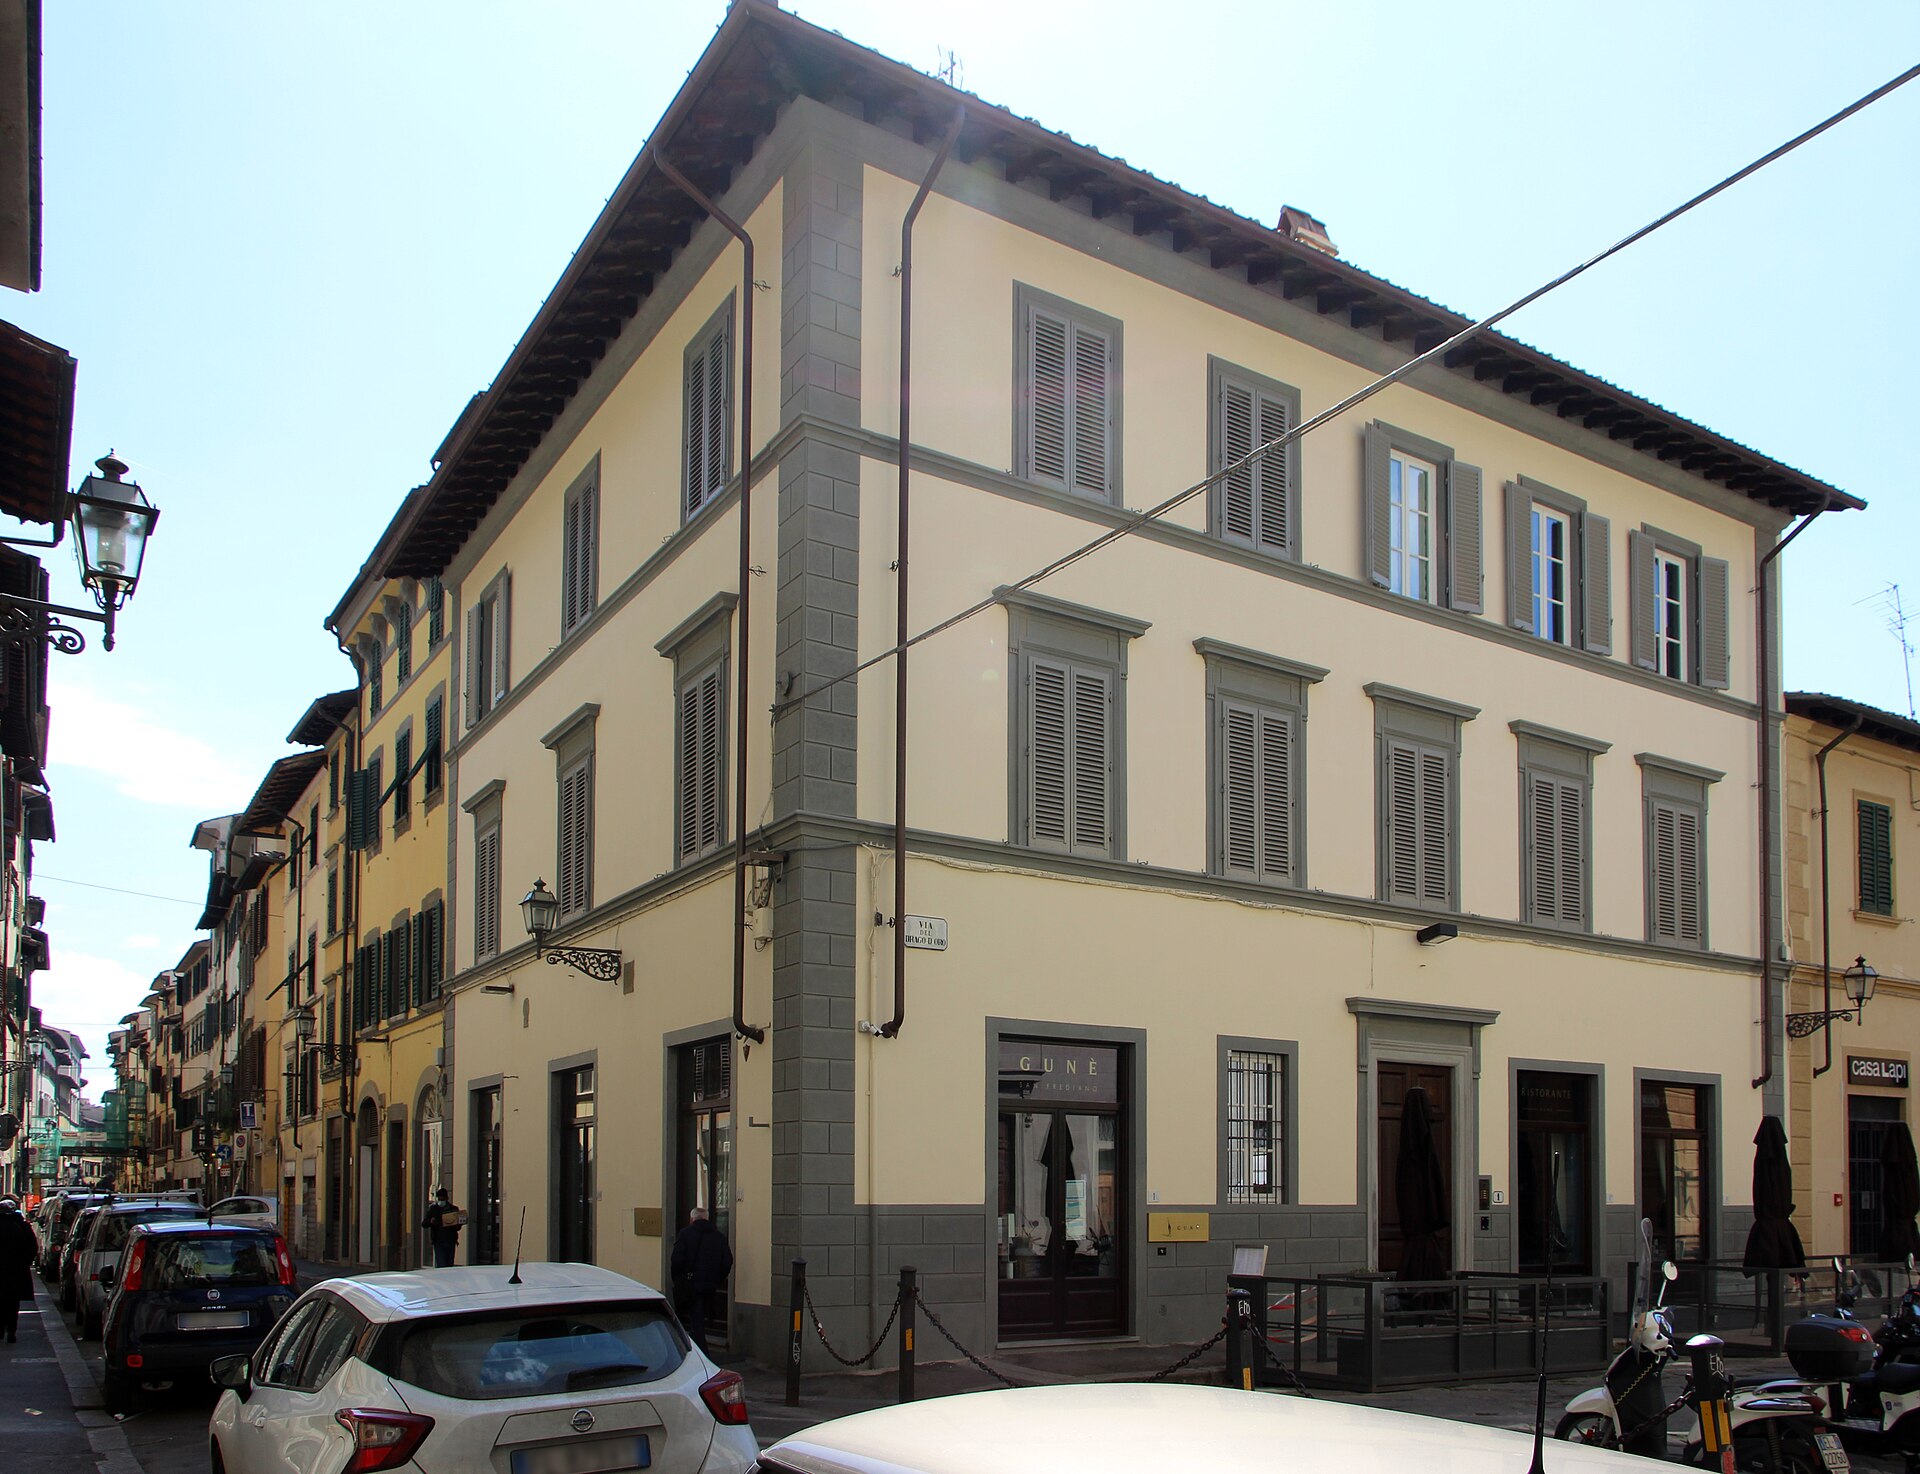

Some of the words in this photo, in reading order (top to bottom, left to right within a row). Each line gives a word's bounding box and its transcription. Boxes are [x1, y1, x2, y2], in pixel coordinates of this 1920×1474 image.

[919, 920, 933, 929] VIA
[905, 935, 926, 944] DRAGO
[1019, 1055, 1098, 1076] GUNÈ
[1018, 1081, 1039, 1090] SAN
[1045, 1082, 1098, 1093] FREDIANO
[1520, 1087, 1573, 1099] RISTORANTE
